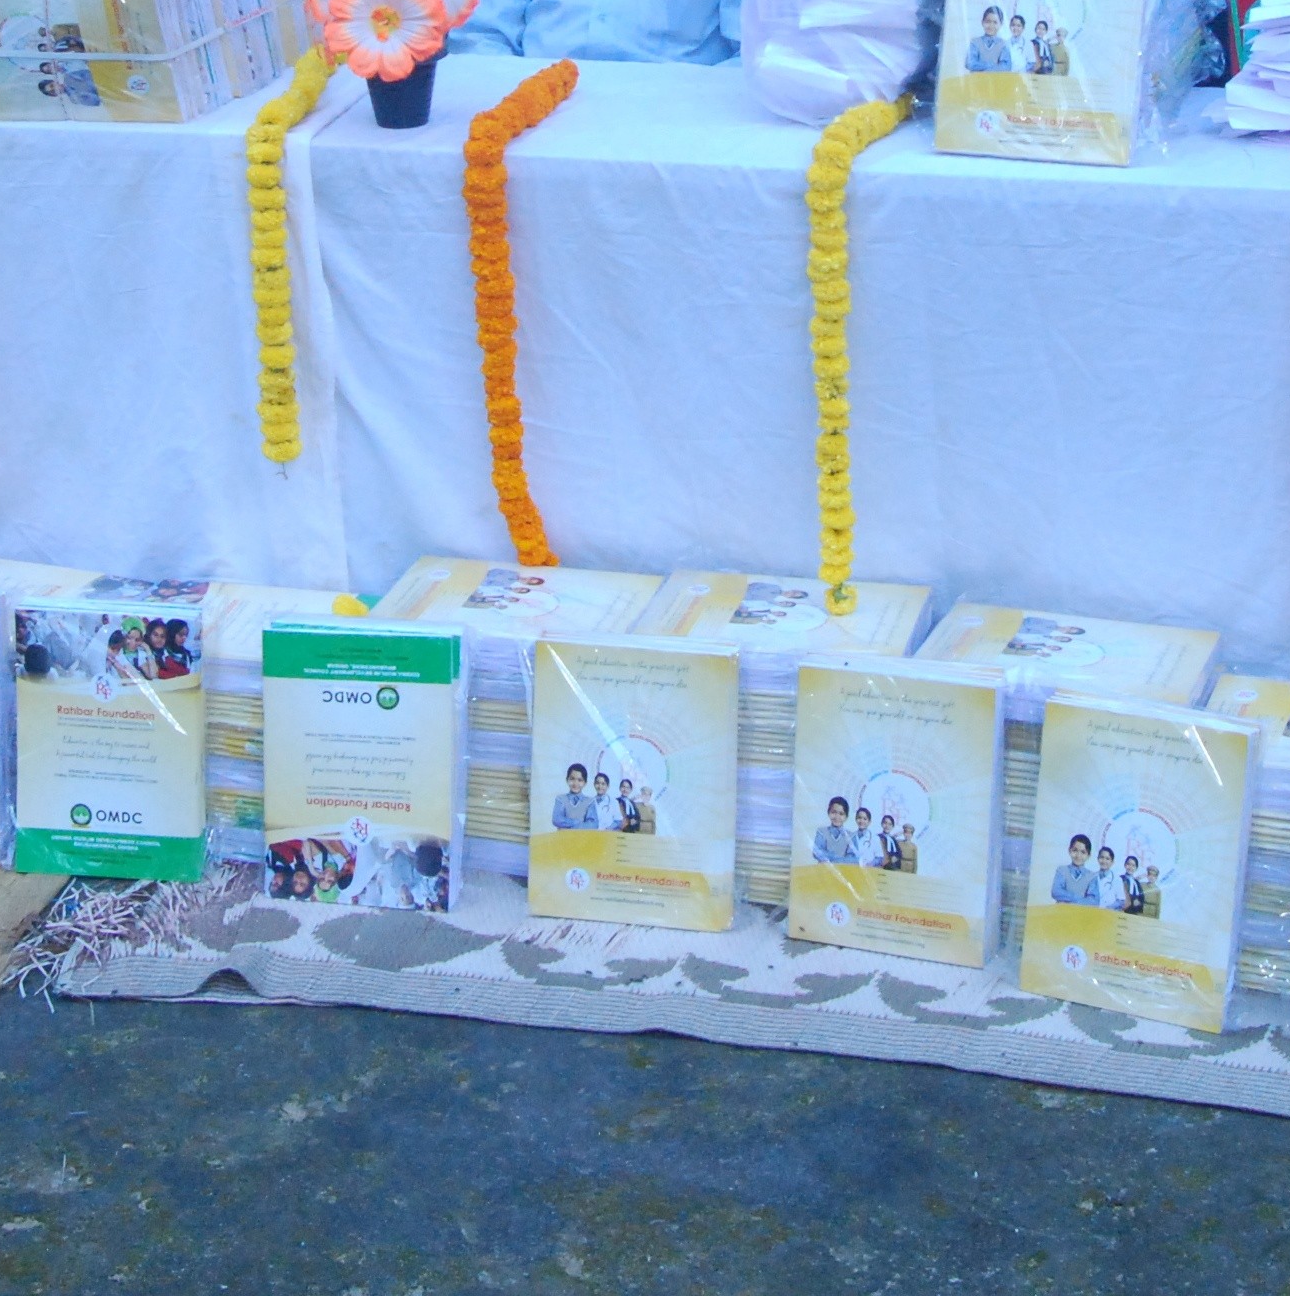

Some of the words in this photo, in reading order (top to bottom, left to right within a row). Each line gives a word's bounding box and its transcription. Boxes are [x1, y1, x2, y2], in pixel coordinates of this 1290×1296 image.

[322, 690, 372, 704] OMDC
[57, 705, 94, 717] Rahbar
[97, 707, 155, 721] Foundation
[306, 798, 369, 810] Foundation
[371, 801, 411, 813] Rahbar
[96, 809, 143, 824] OMDC
[596, 871, 632, 883] Rahbar
[634, 875, 691, 888] Foundation
[895, 913, 952, 930] Foundation
